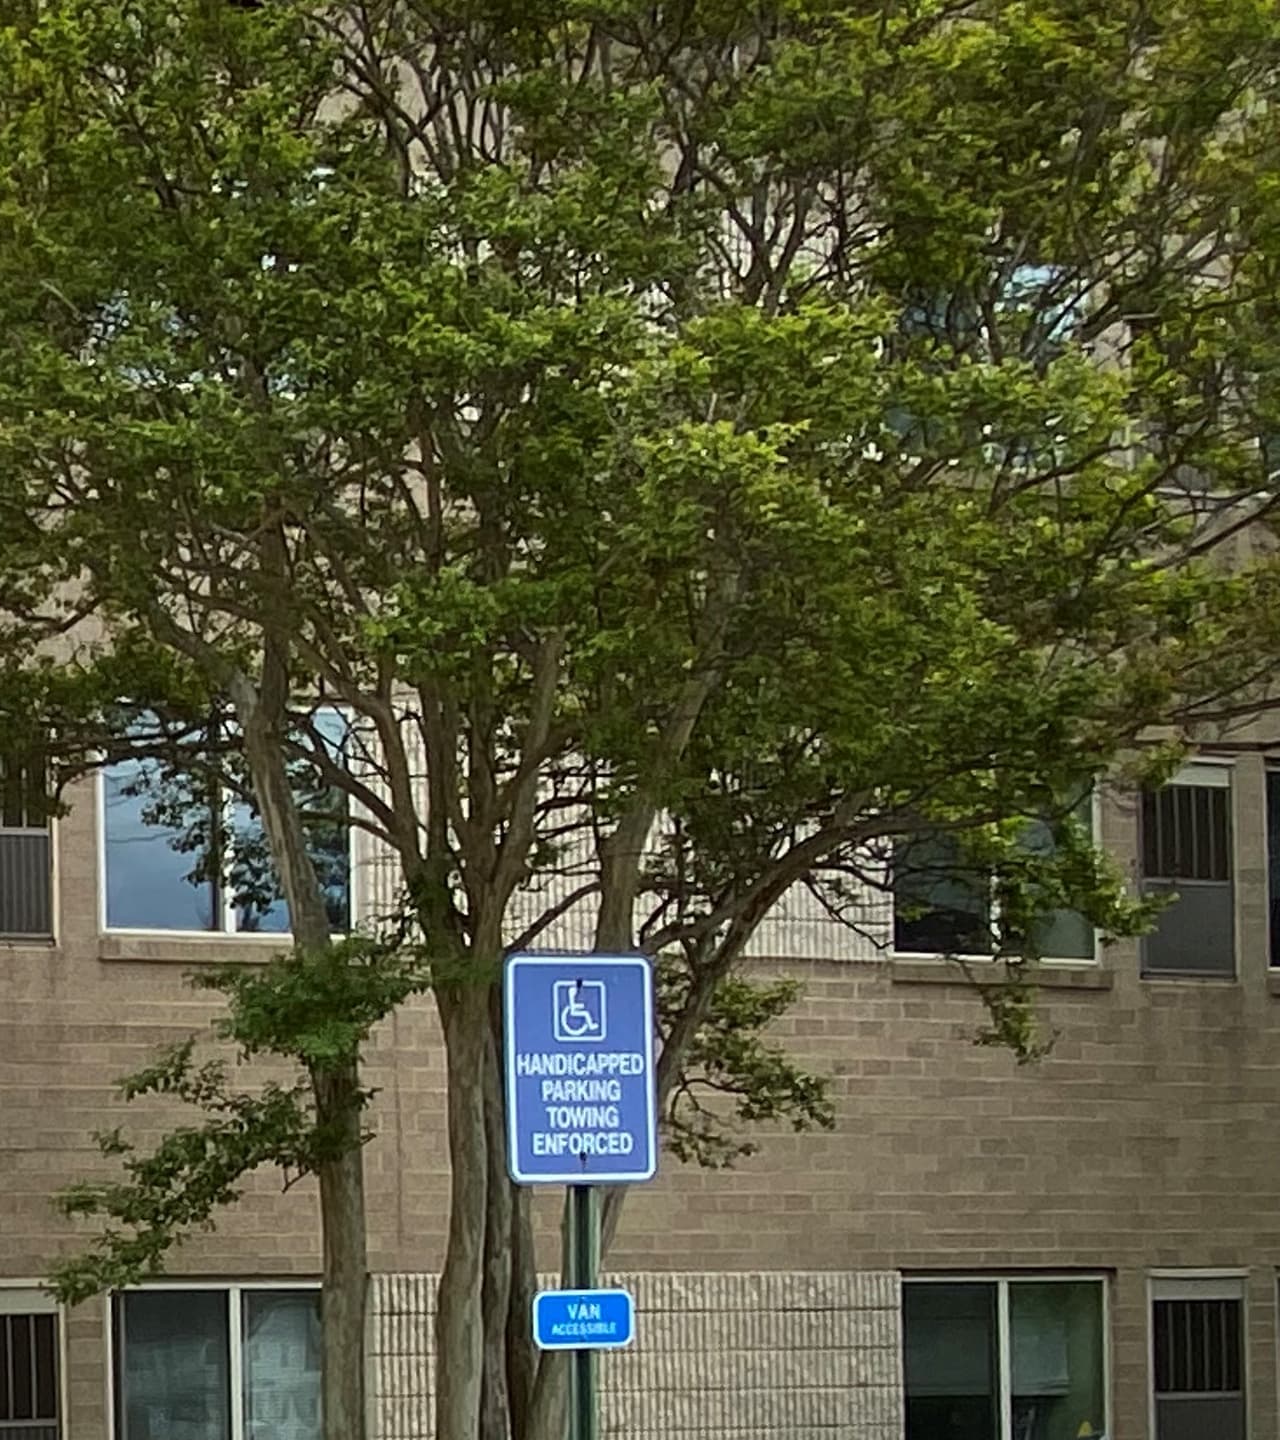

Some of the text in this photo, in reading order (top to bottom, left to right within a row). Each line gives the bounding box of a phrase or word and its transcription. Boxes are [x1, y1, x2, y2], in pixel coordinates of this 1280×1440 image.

[517, 1052, 644, 1076] HANDICAPPED
[541, 1079, 621, 1102] PARKING
[545, 1106, 620, 1129] TOWING
[532, 1132, 634, 1155] ENFORCED
[566, 1302, 601, 1320] VAN
[551, 1321, 617, 1336] ACCESSIBLE
